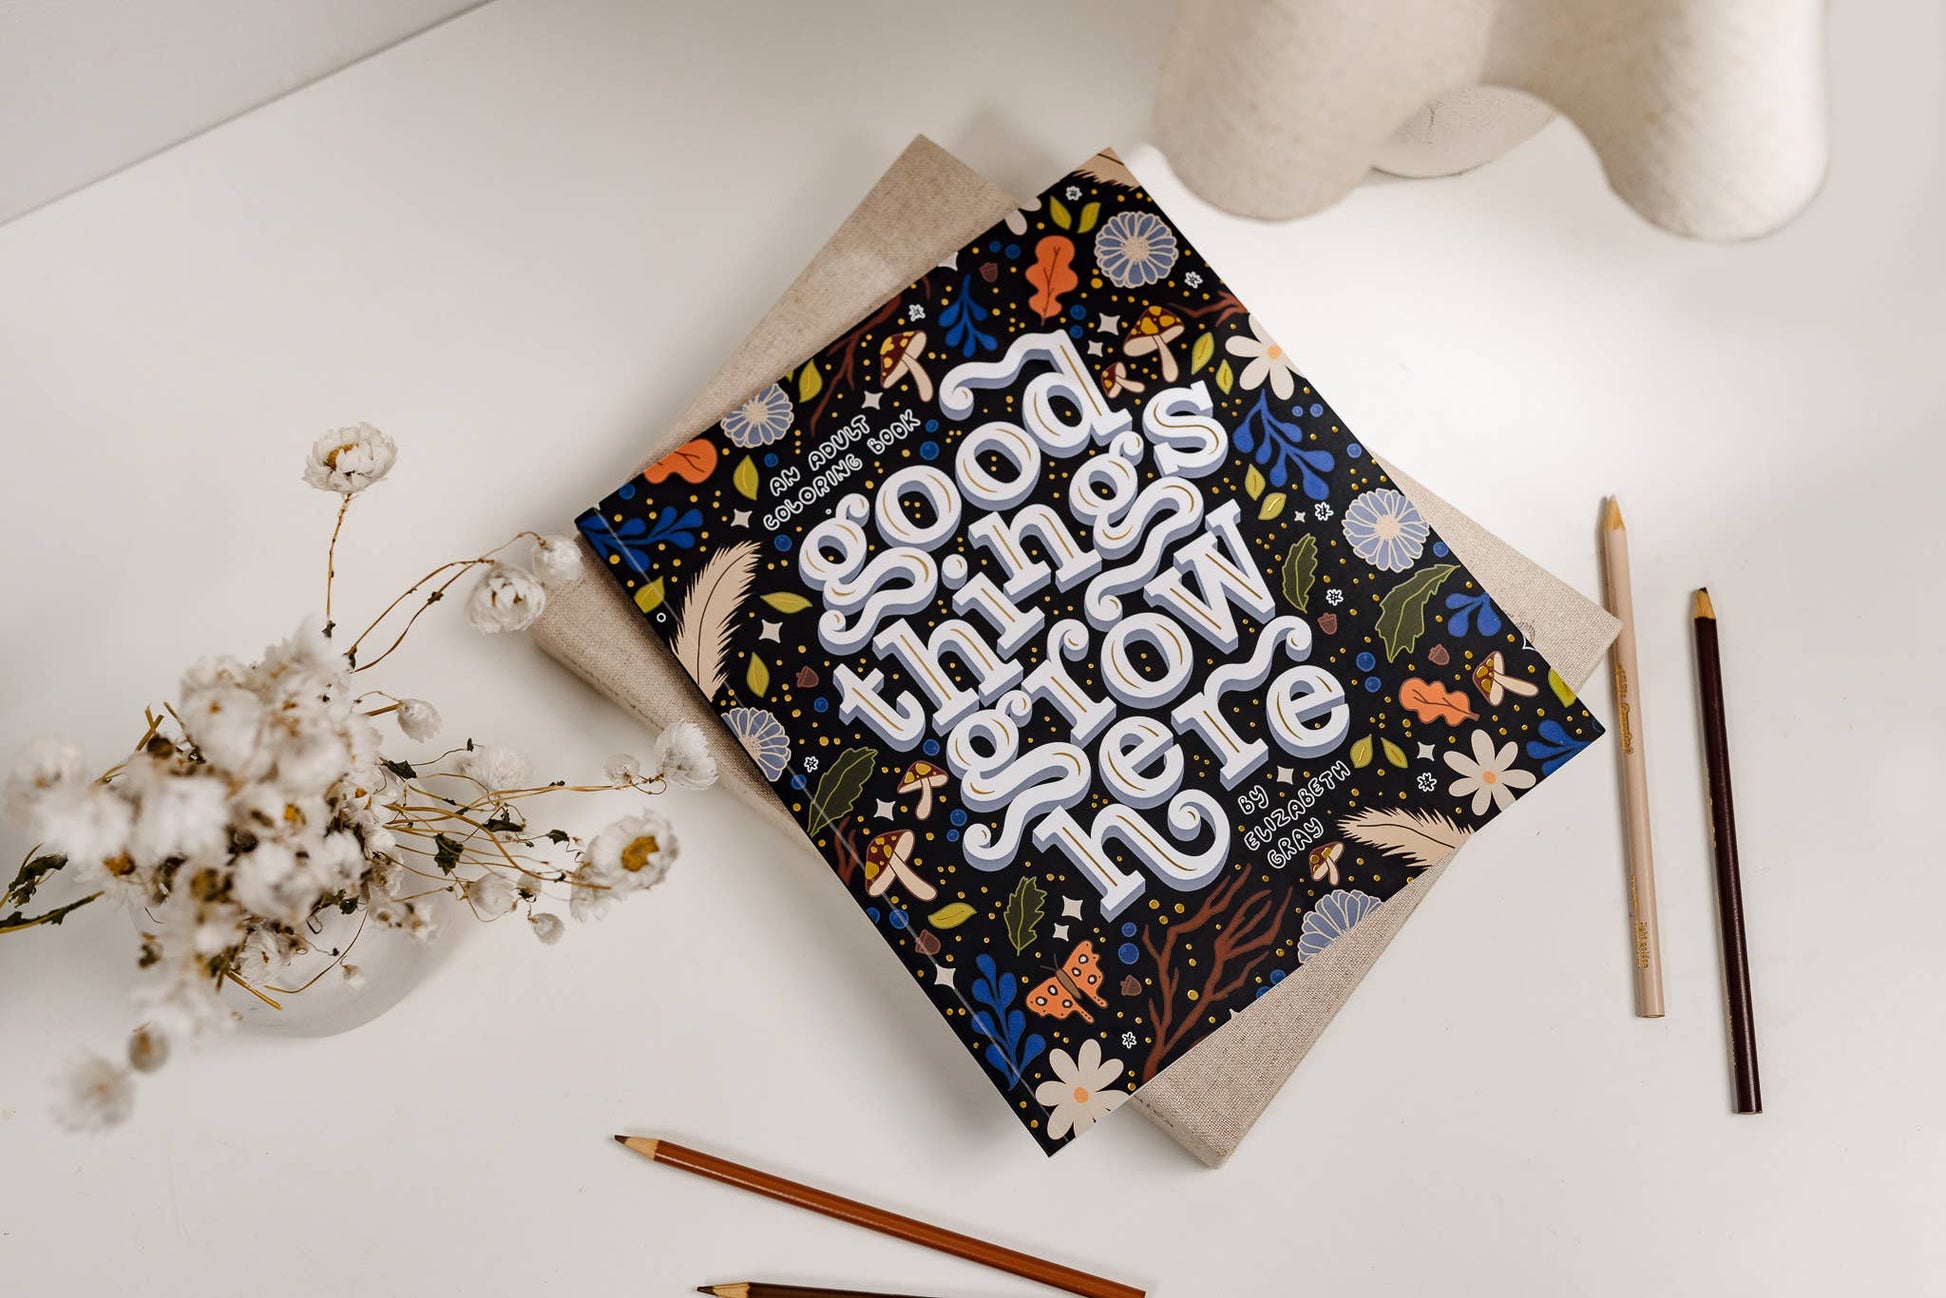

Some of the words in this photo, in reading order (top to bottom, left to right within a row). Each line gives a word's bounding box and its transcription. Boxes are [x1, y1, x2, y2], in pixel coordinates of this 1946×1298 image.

[763, 453, 863, 531] COLORING
[866, 409, 921, 455] BOOK
[769, 466, 800, 497] AN
[808, 414, 870, 471] ADULT
[799, 329, 1132, 655] good
[833, 381, 1228, 751] things
[946, 500, 1277, 872] grow
[1032, 616, 1350, 923] here
[1237, 784, 1269, 815] BY
[1244, 760, 1351, 851] ELIZABETH
[1267, 817, 1324, 869] GRAY
